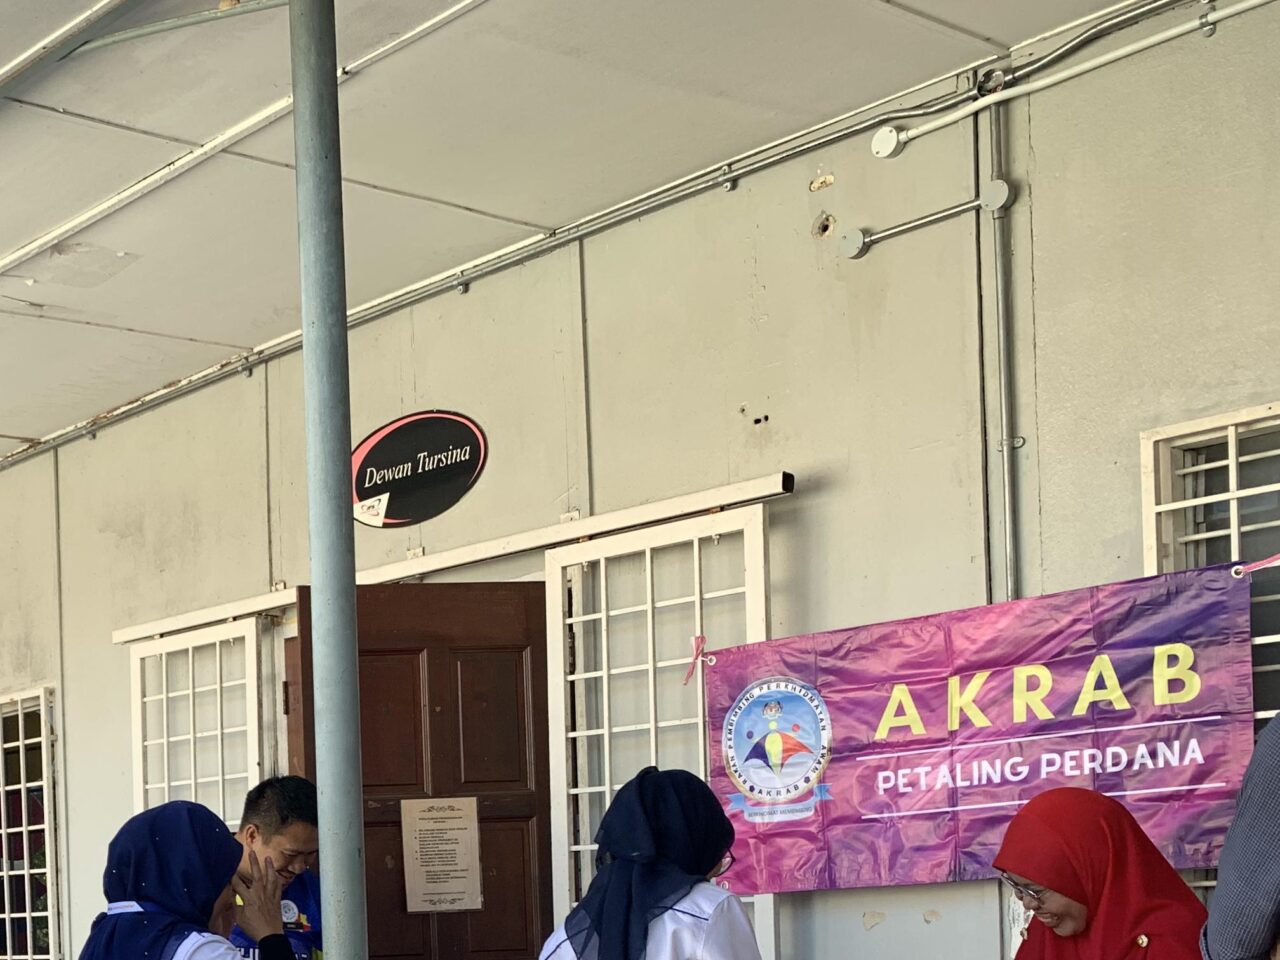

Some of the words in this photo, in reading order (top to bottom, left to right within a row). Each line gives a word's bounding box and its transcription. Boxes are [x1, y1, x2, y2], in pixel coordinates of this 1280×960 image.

[364, 461, 411, 488] Dewan
[417, 445, 470, 473] Tursina
[727, 692, 755, 750] PEMBIMBING
[759, 682, 827, 732] PERKHIDMATAN
[874, 642, 1201, 740] AKRAB
[757, 784, 800, 797] AKRAB
[877, 756, 1030, 795] PETALING
[1040, 738, 1205, 779] PERDANA
